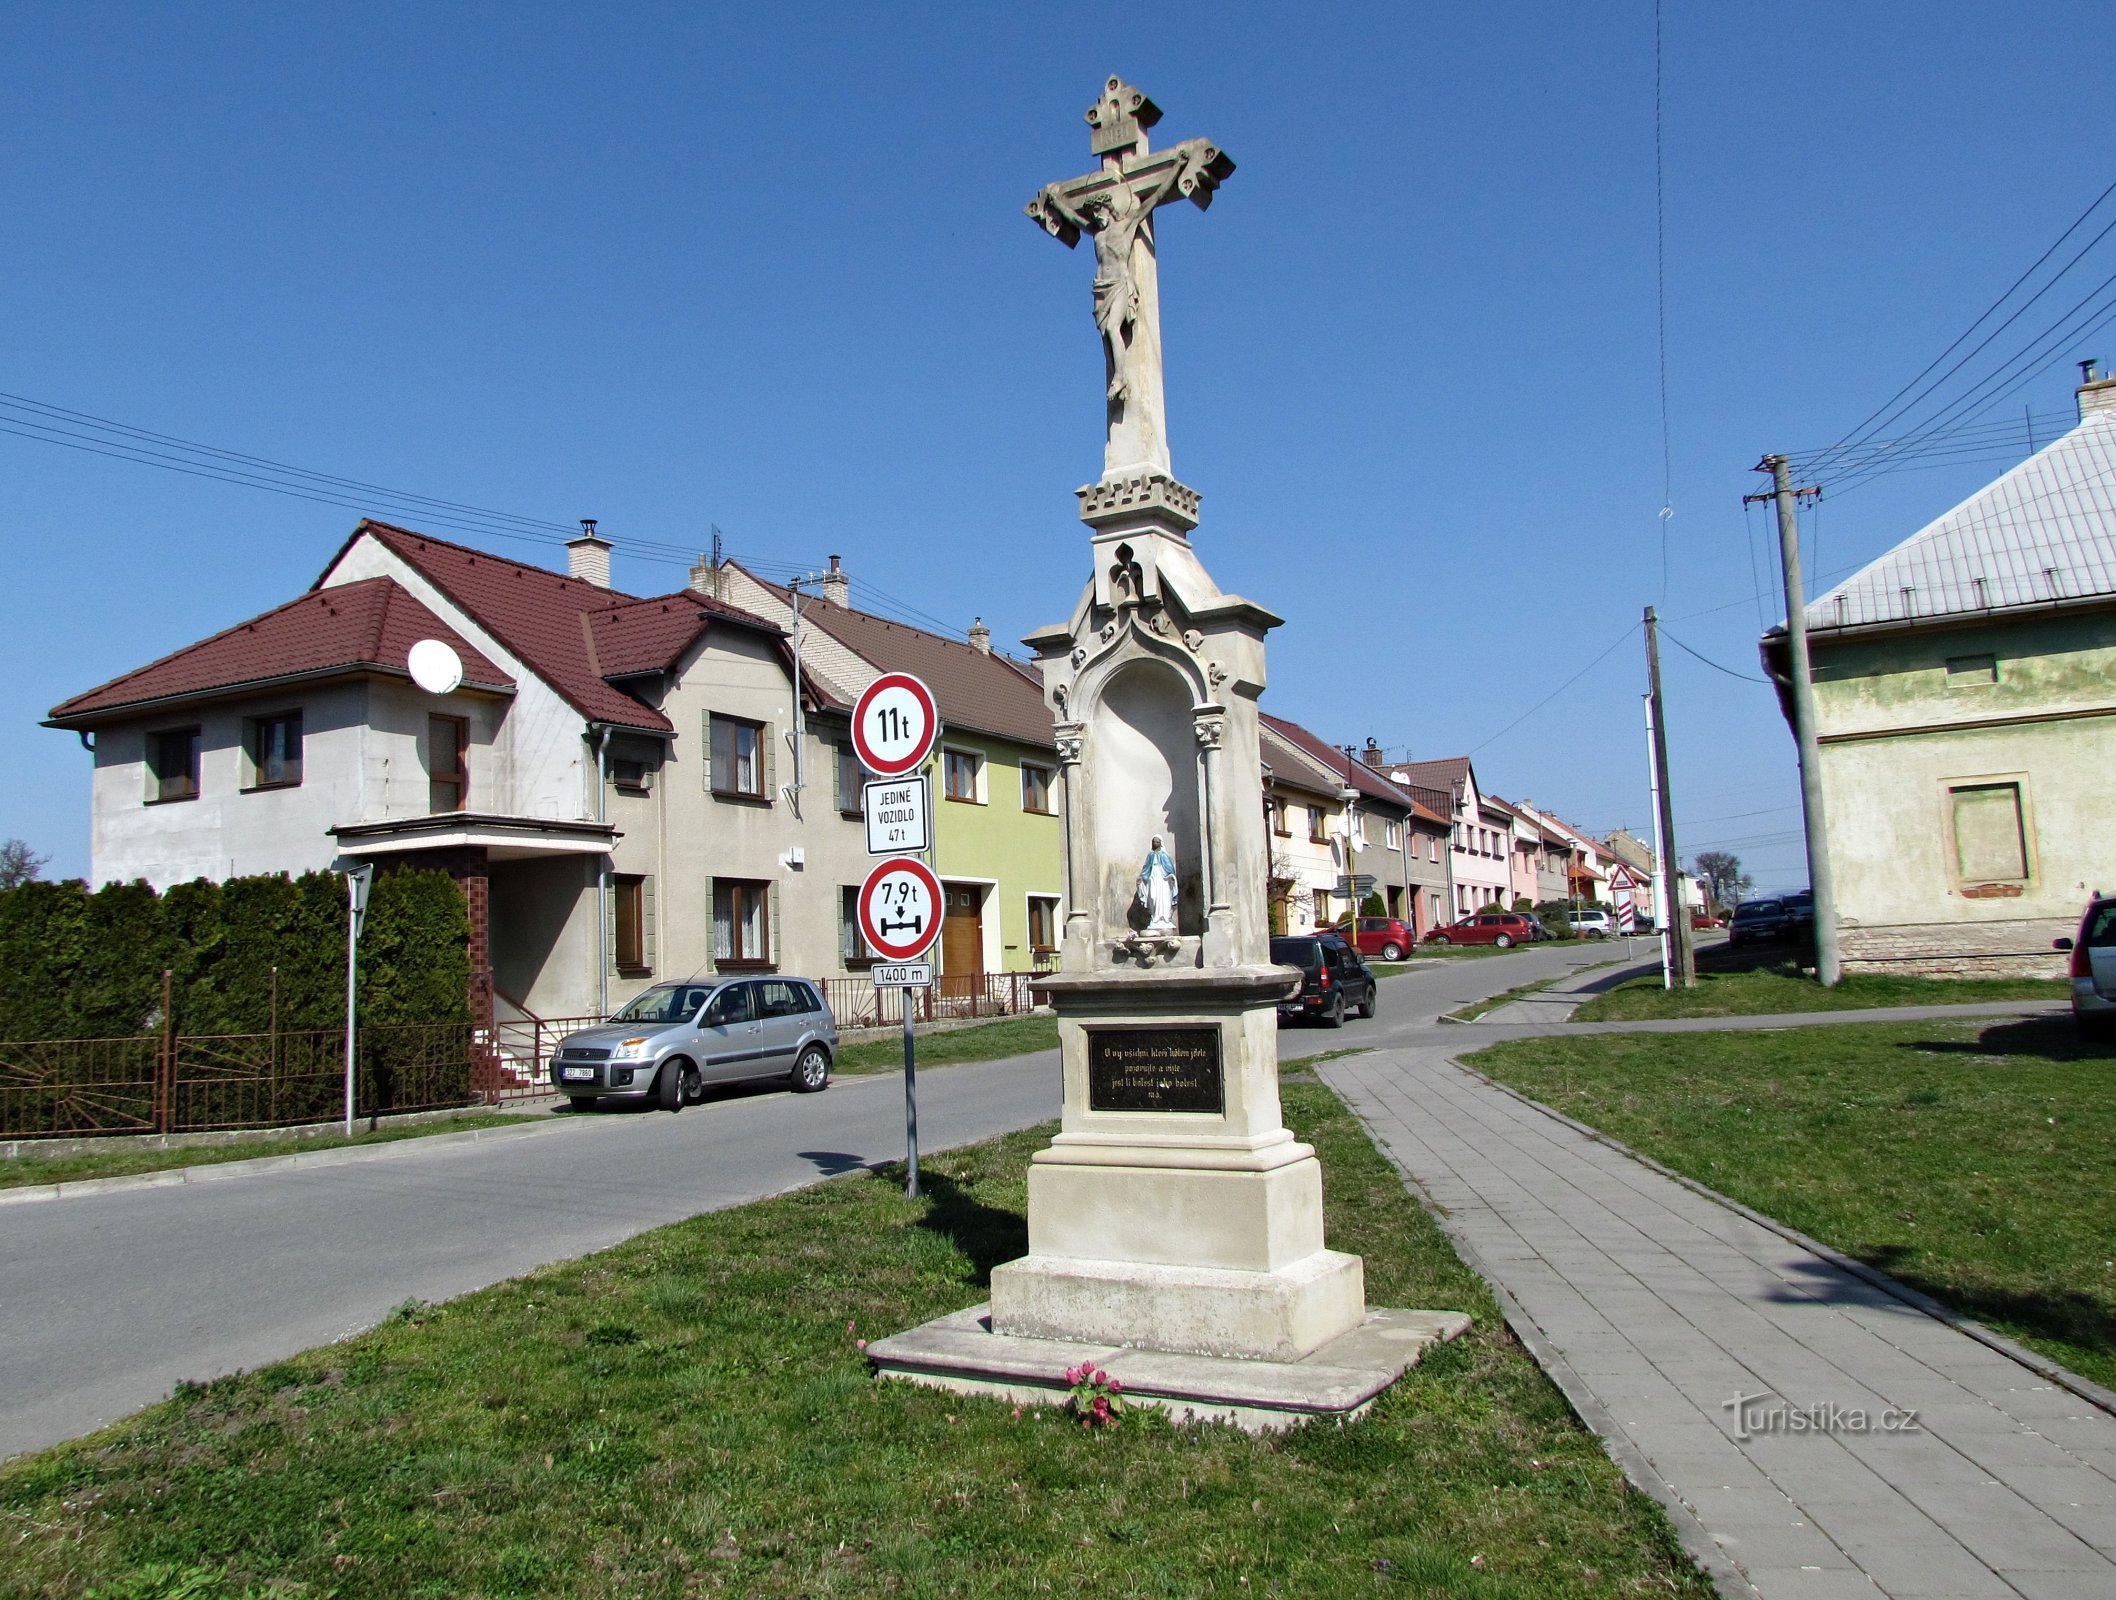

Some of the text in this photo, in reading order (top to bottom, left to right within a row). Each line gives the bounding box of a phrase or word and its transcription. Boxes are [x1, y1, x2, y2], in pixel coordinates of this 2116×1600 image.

[878, 707, 910, 742] 11 t
[880, 786, 911, 805] JEDINÉ
[878, 808, 914, 824] VOZIDLO
[888, 829, 905, 842] 47 t
[882, 882, 917, 905] 7,9 t
[880, 968, 923, 981] 1400 m
